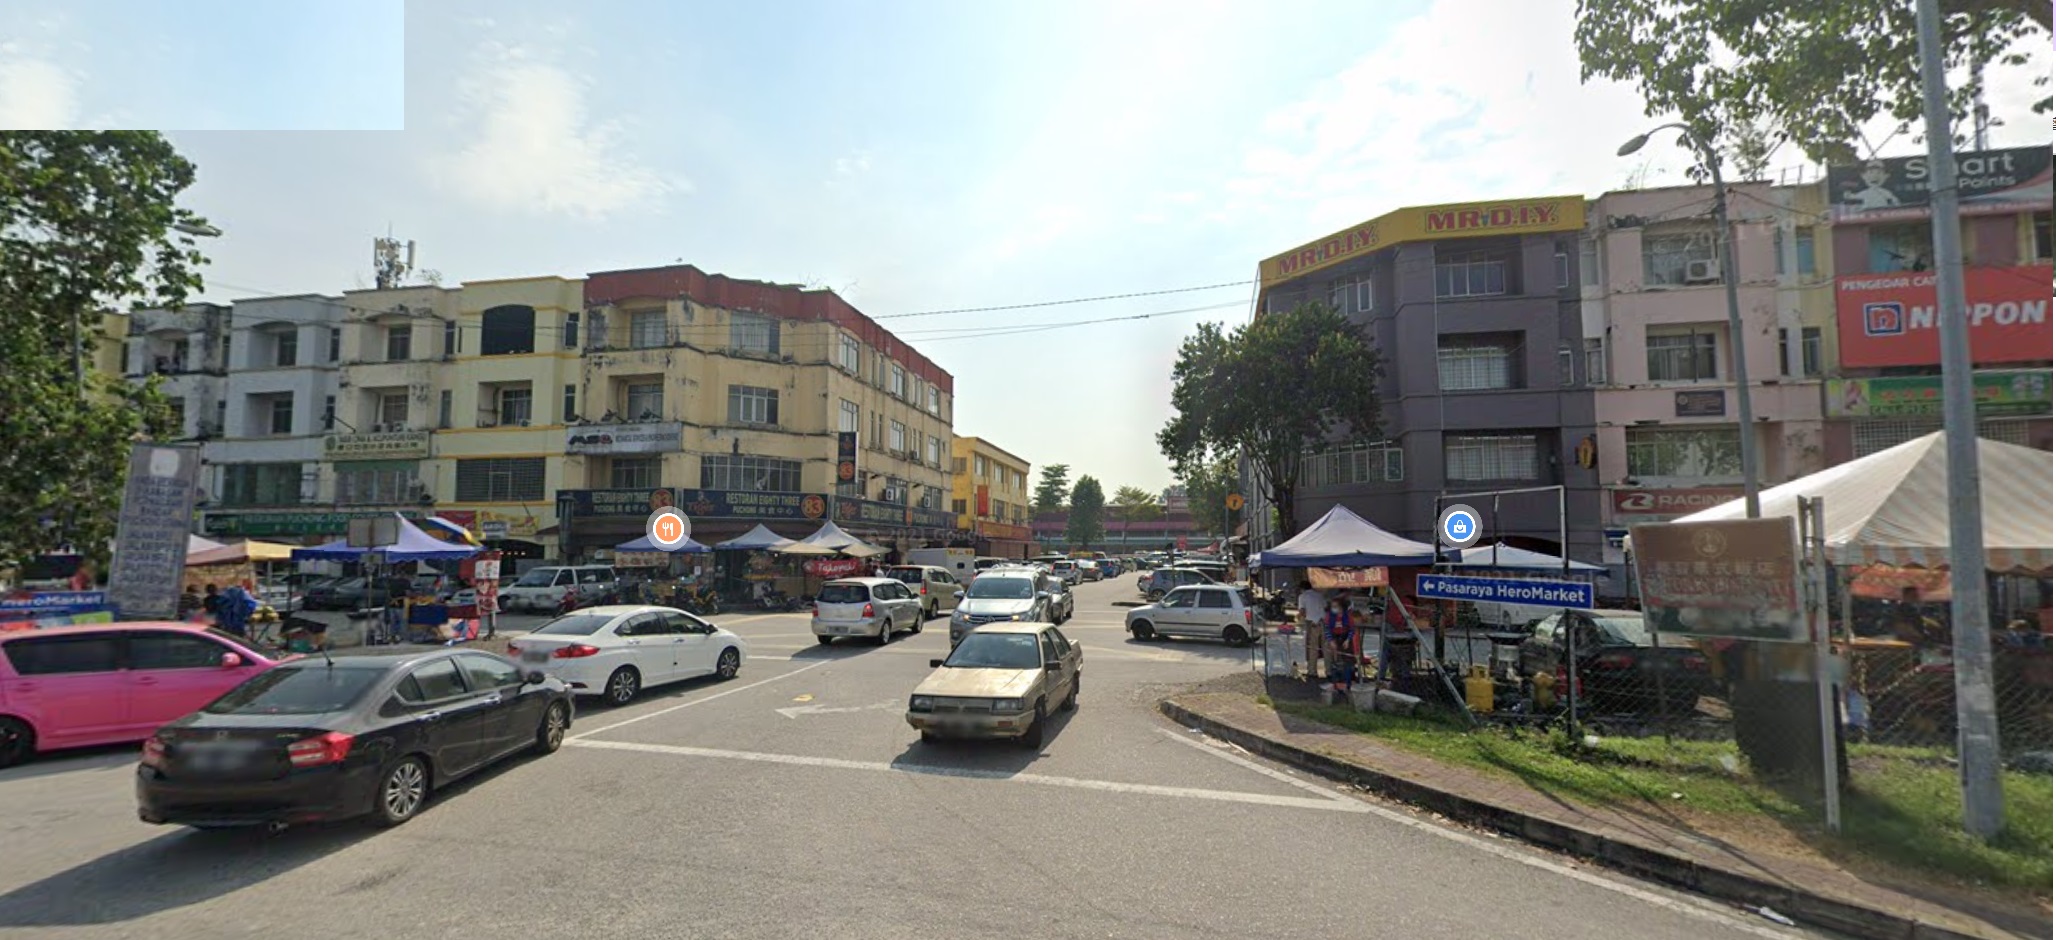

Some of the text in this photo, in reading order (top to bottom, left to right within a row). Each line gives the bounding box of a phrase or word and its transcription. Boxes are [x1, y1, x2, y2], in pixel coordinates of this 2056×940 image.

[1905, 152, 2014, 179] Sart
[1958, 175, 2016, 189] Points
[1841, 278, 1910, 290] PENGEDAR
[1909, 299, 2047, 329] NPON
[805, 498, 822, 514] 83
[1437, 581, 1585, 603] Pasaraya HeroMarket
